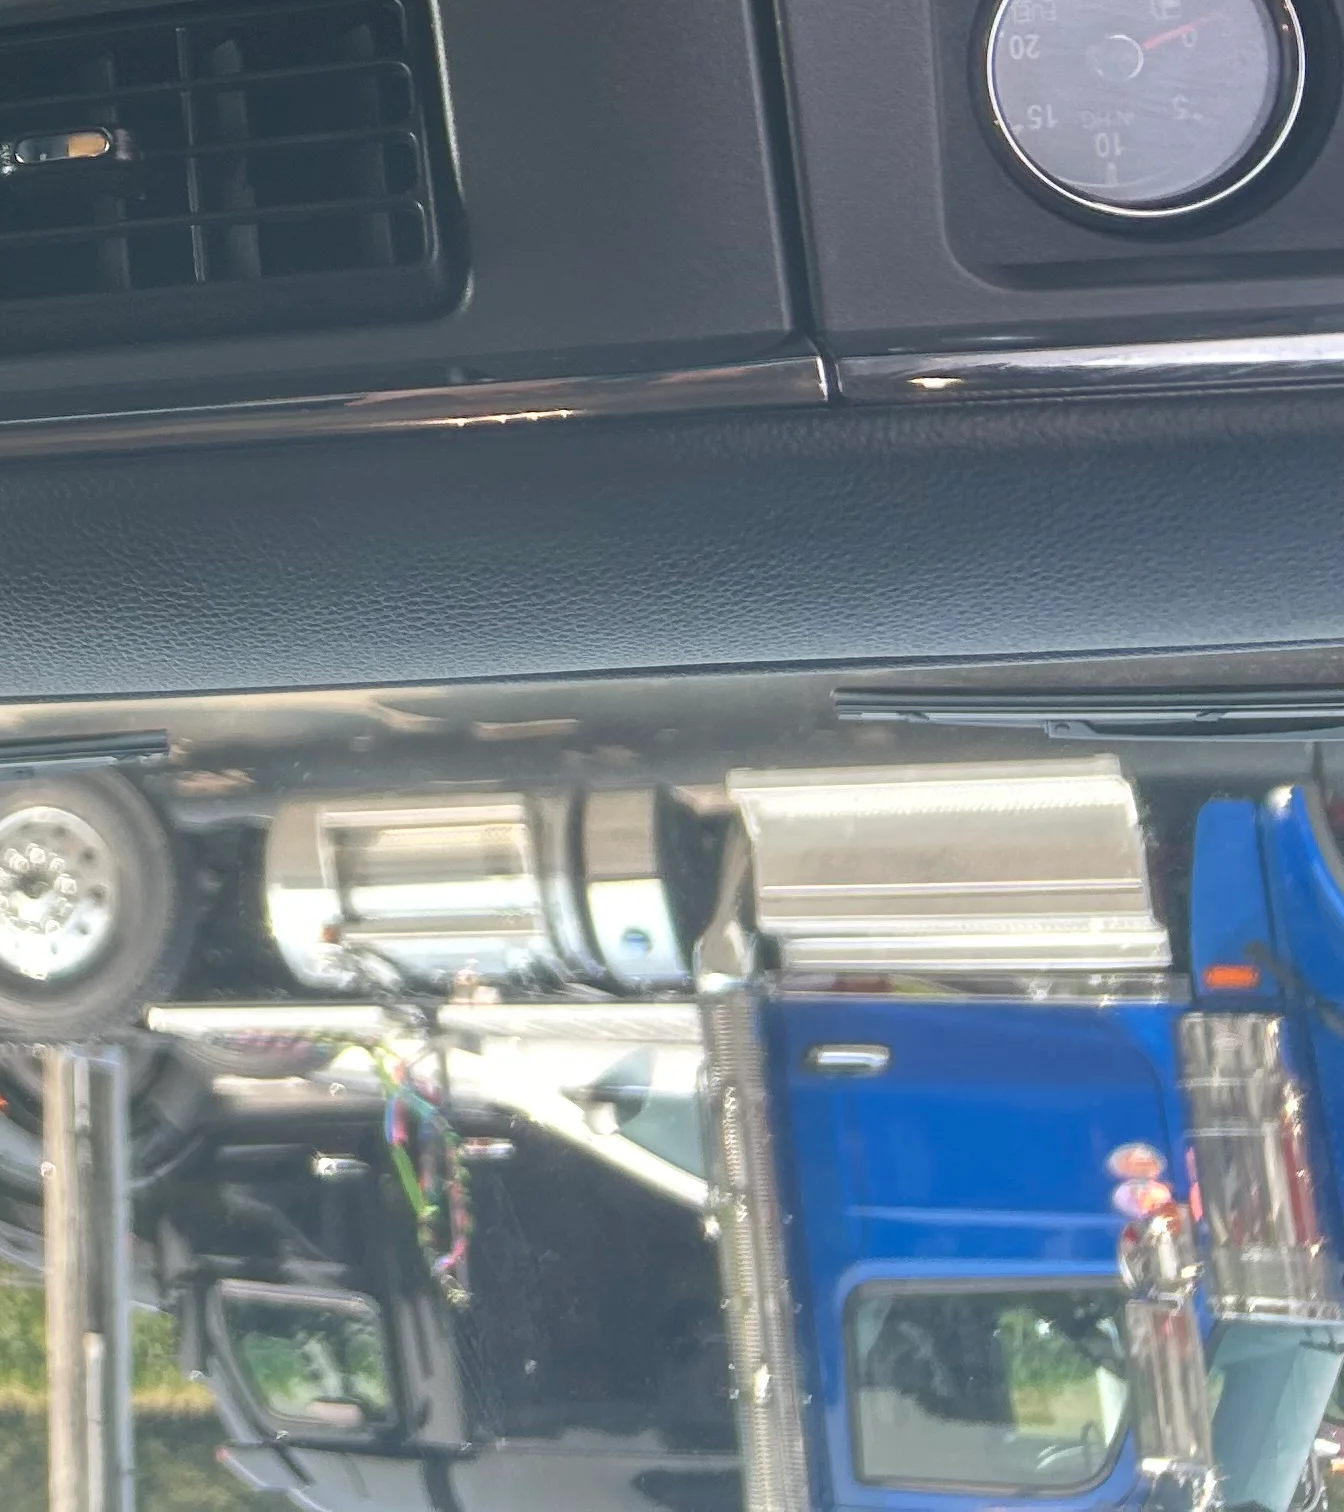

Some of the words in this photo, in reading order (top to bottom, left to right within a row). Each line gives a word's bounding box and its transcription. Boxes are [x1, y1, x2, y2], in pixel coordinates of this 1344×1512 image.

[1009, 34, 1040, 60] 20
[1027, 104, 1058, 128] 15
[1095, 133, 1124, 157] 10
